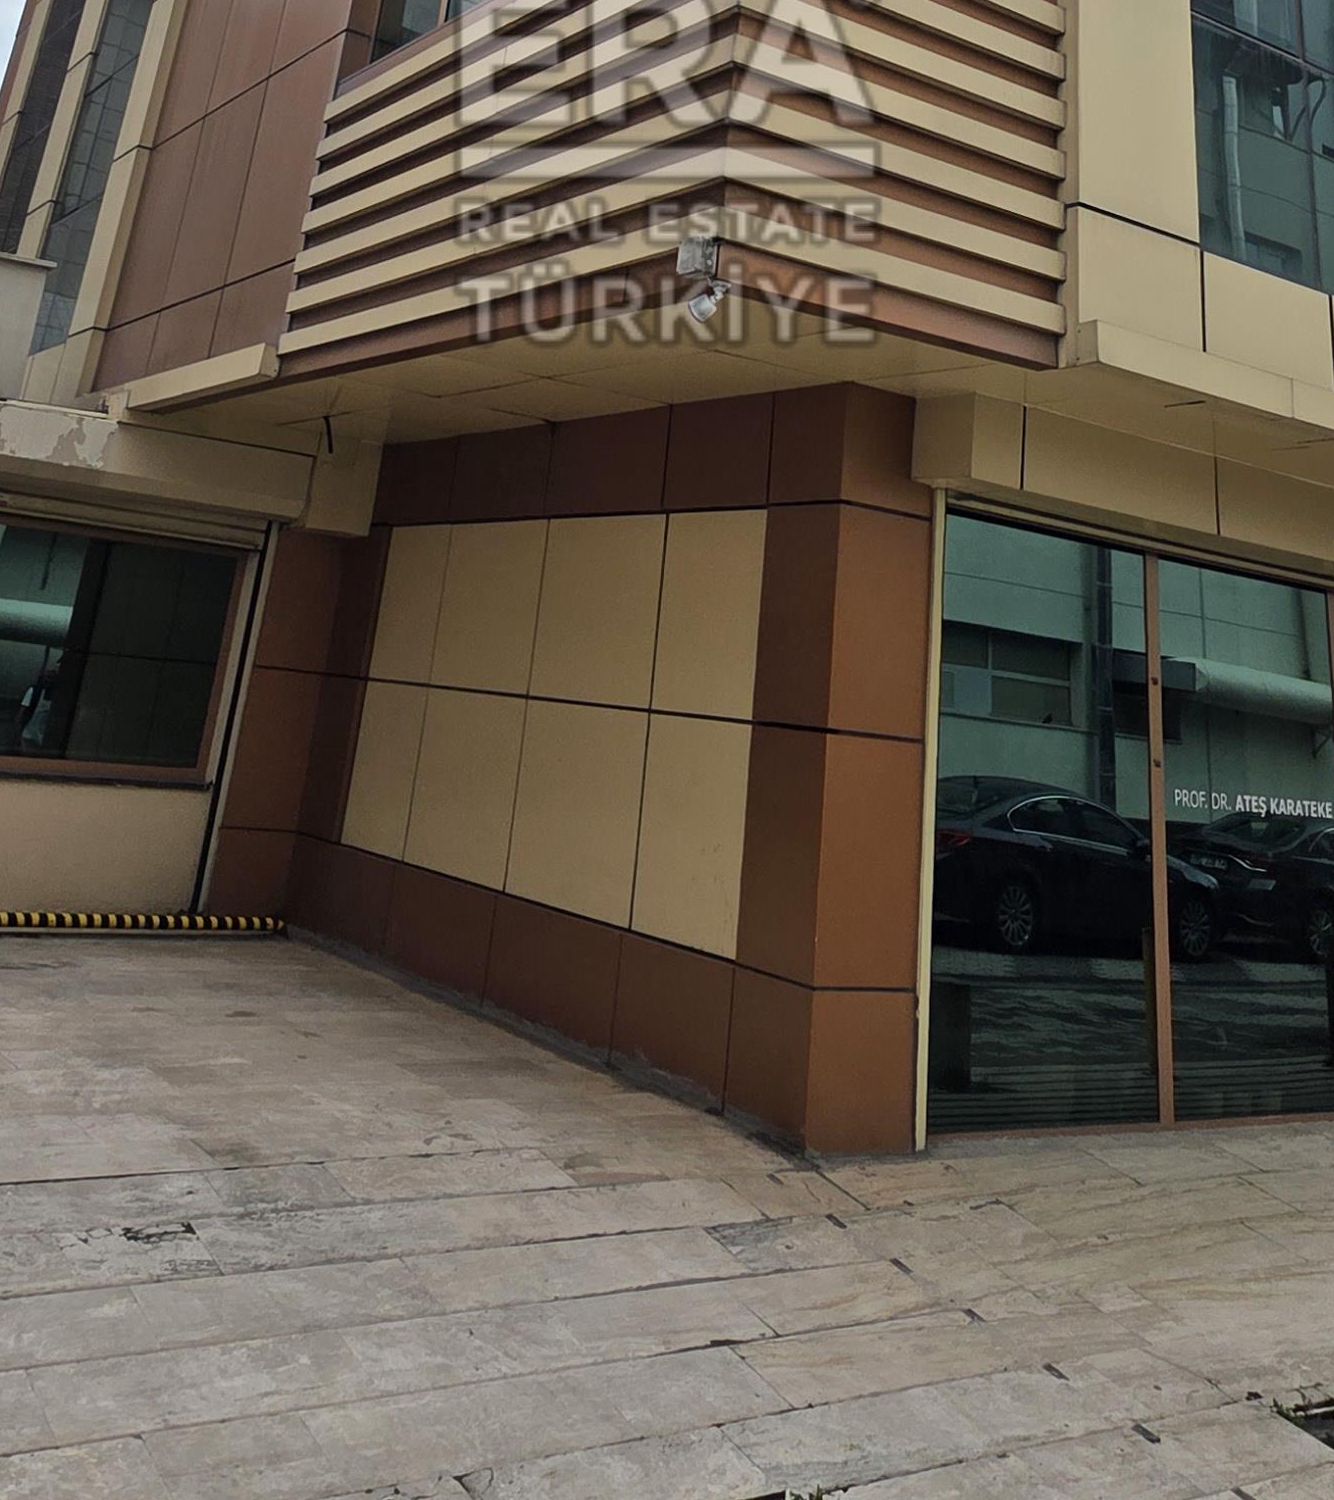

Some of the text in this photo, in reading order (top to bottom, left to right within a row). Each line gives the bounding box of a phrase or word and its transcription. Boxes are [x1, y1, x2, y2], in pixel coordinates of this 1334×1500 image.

[1174, 788, 1333, 819] PROF. DR. ATEŞ KARATEKE
